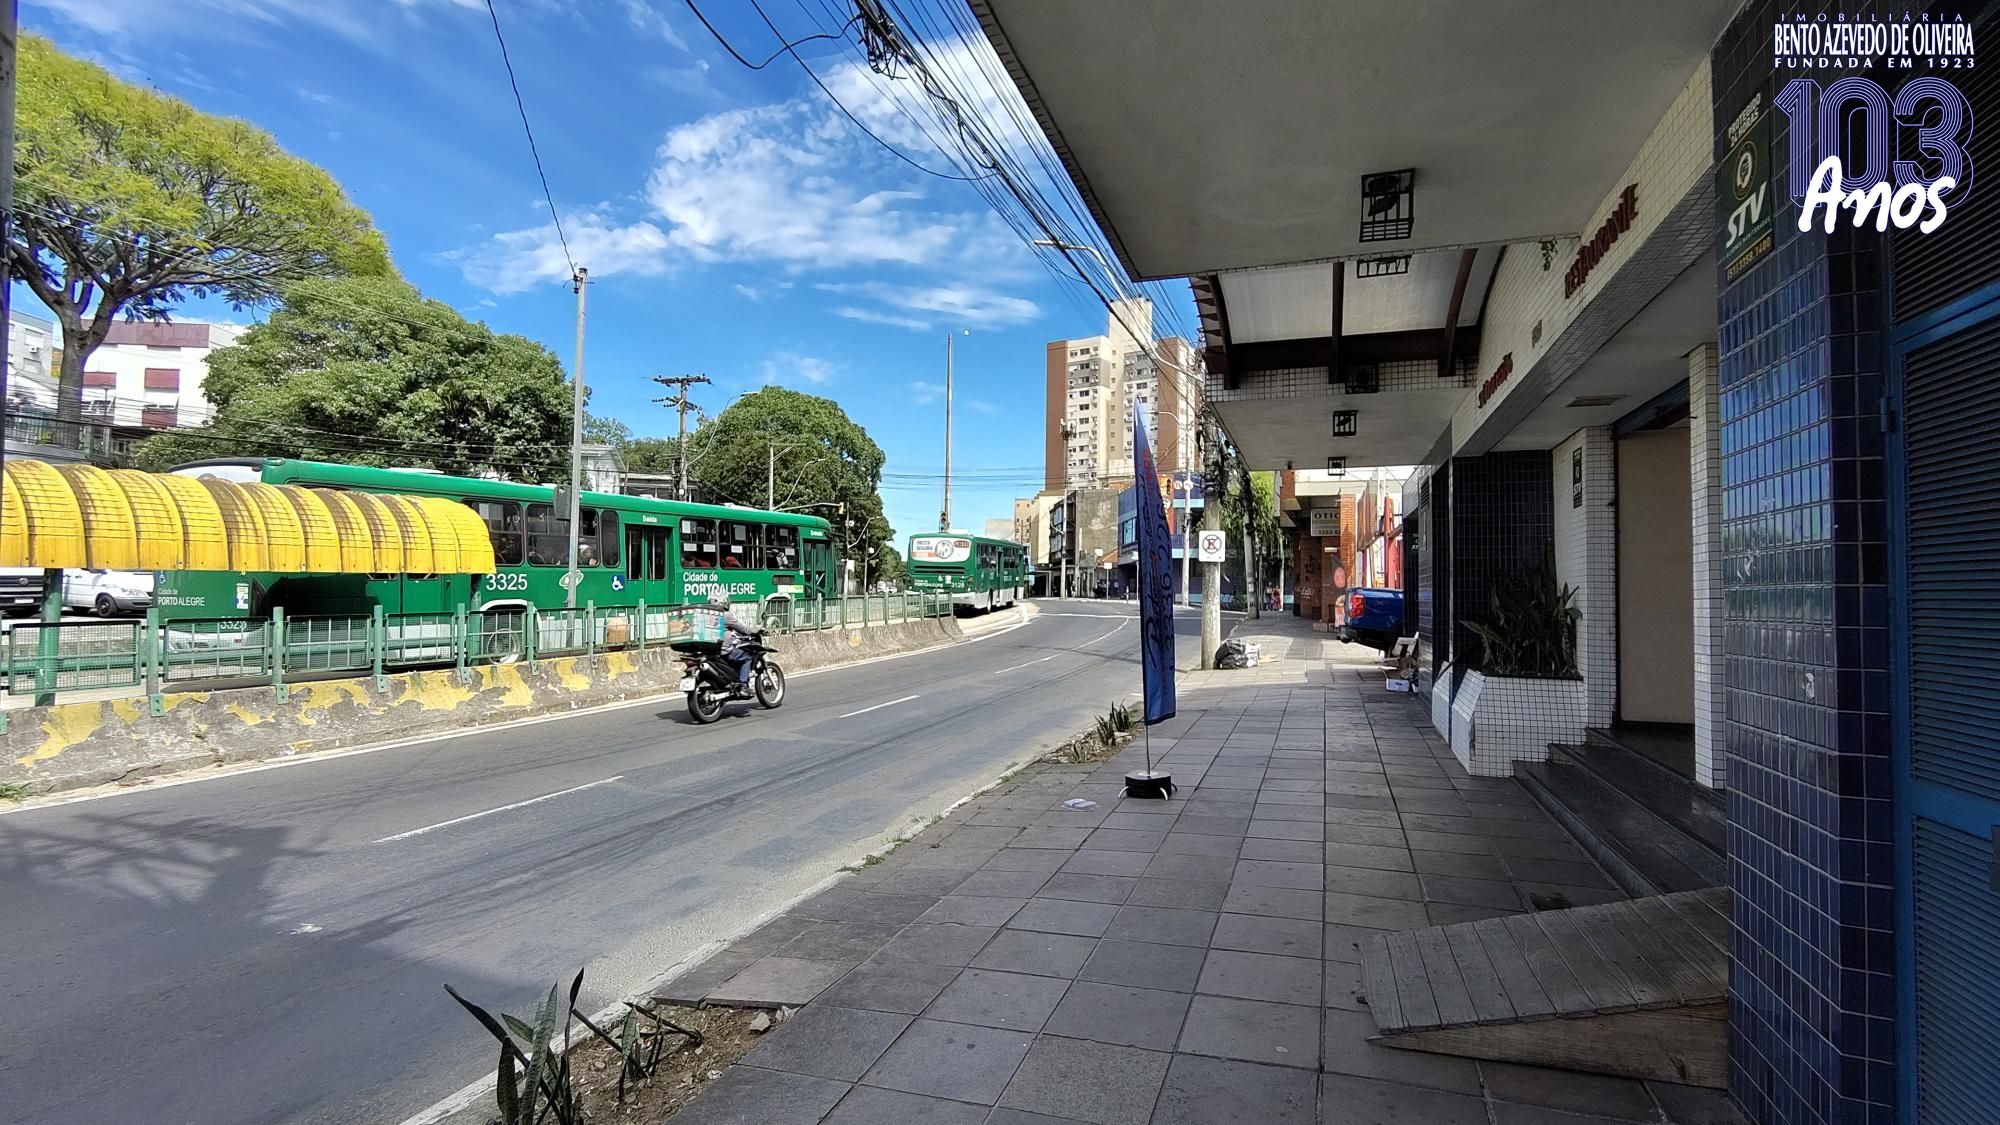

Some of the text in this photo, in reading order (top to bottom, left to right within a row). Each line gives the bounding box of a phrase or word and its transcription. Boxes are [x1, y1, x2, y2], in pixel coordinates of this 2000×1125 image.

[1726, 181, 1768, 249] STV
[485, 573, 528, 591] 3325
[683, 570, 718, 582] Cidade de
[158, 596, 205, 606] PORTO ALEGRE
